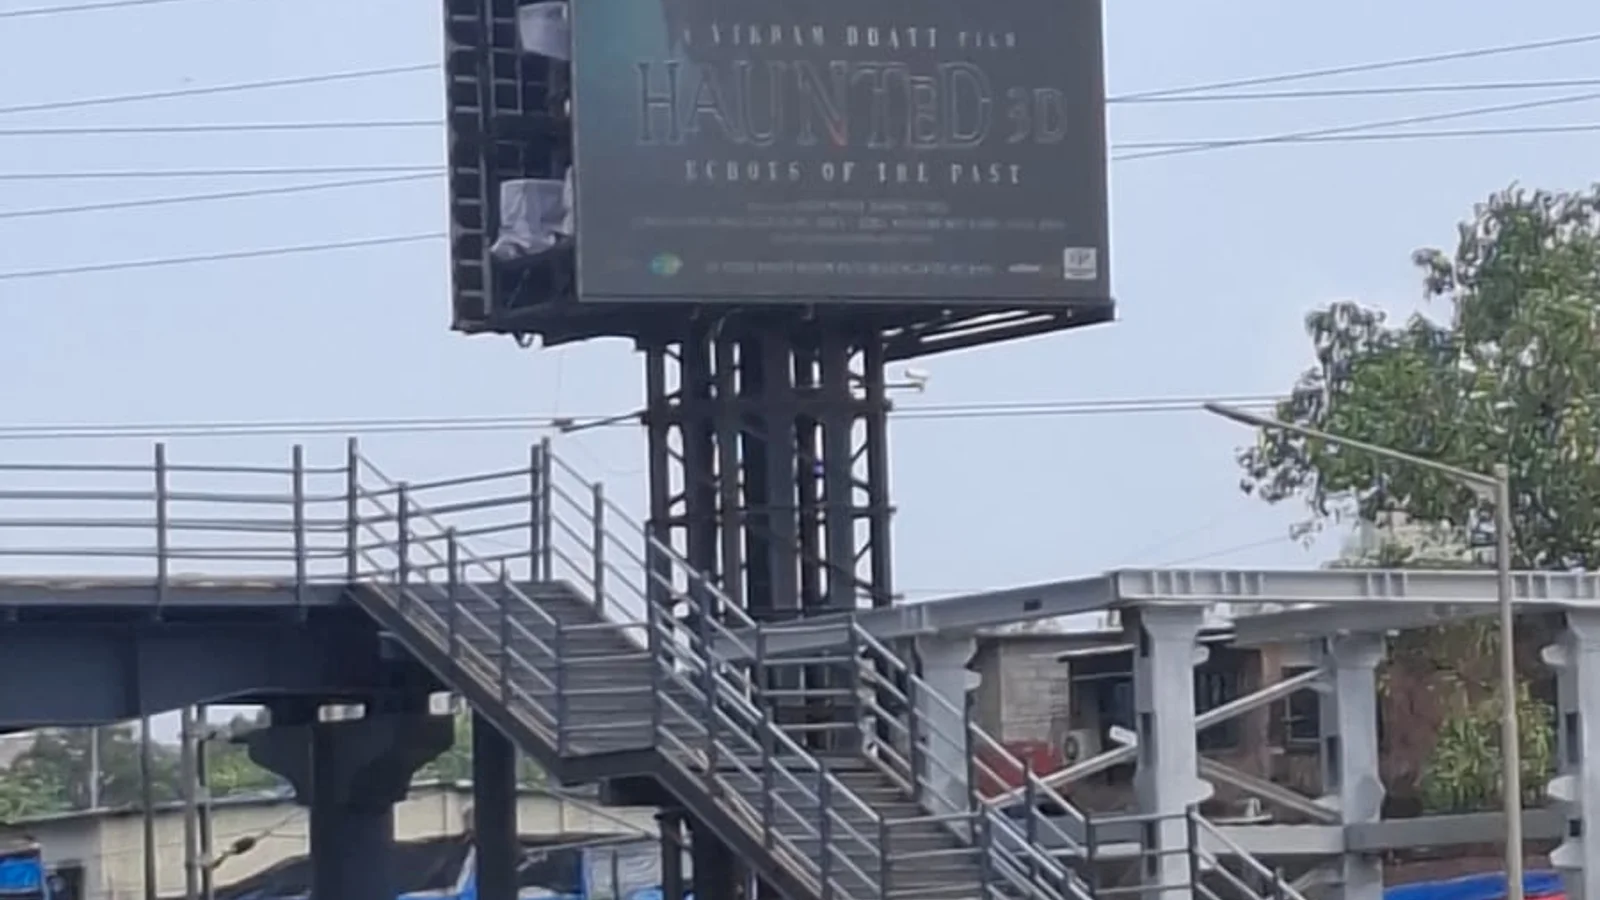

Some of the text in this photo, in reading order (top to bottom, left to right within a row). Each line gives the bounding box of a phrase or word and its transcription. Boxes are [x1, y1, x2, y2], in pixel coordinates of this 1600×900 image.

[634, 58, 1068, 149] HAUNTED 3D
[820, 161, 857, 183] OF
[949, 162, 1021, 185] PAST
